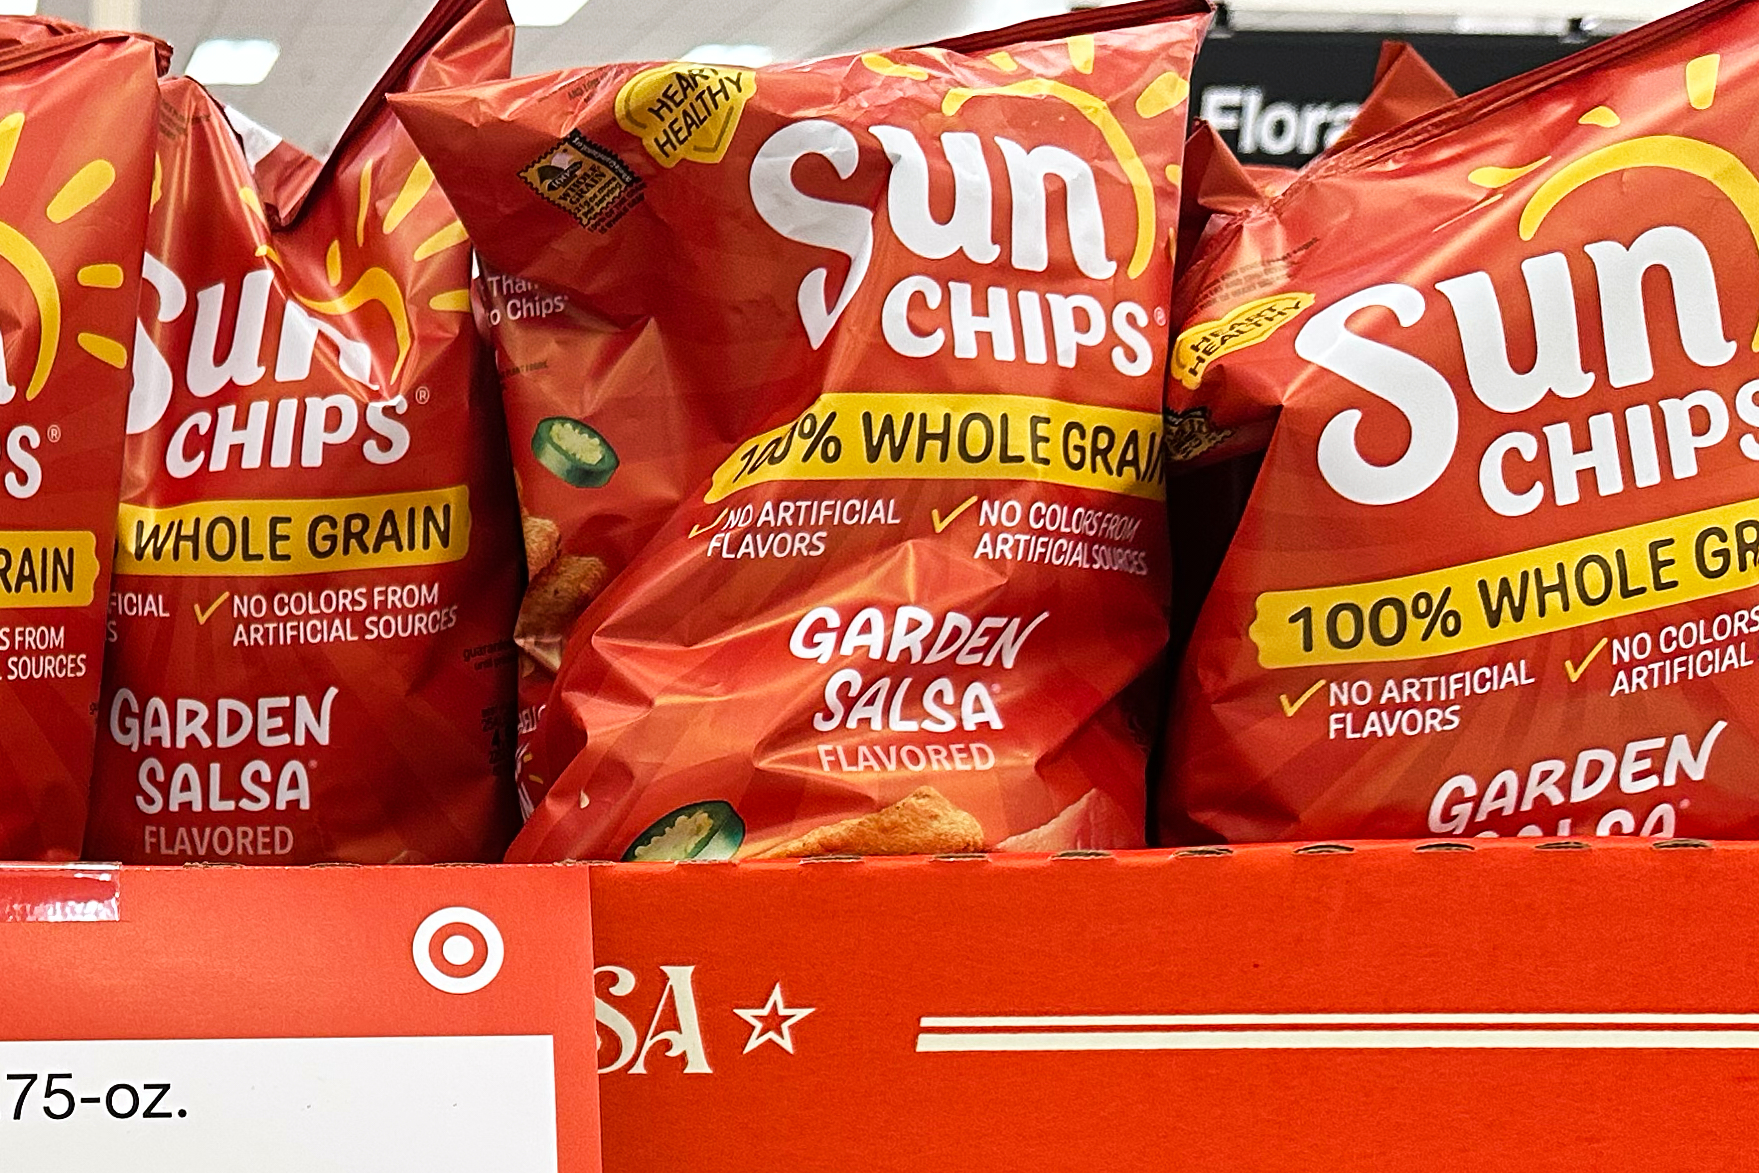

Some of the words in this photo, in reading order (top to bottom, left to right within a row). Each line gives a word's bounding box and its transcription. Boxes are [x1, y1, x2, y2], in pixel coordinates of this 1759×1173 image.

[654, 72, 743, 158] HEALTHY
[749, 119, 1118, 351] Sun
[1187, 301, 1302, 377] HEALTHY
[1294, 226, 1738, 505] Sun
[861, 410, 1051, 466] WHOLE
[135, 515, 293, 564] WHOLE
[306, 503, 452, 559] GRAIN
[723, 506, 756, 530] NO
[757, 498, 901, 528] ARTIFICIAL
[979, 499, 1021, 528] NO
[1029, 502, 1100, 538] COLORS
[706, 530, 827, 559] FLAVORS
[973, 531, 1091, 568] ARTIFICIAL
[233, 595, 267, 618] NO
[273, 588, 367, 614] COLORS
[373, 582, 440, 609] FROM
[1288, 586, 1462, 653] 100%
[1477, 536, 1679, 629] WHOLE
[15, 625, 65, 650] FROM
[233, 618, 359, 647] ARTIFICIAL
[365, 604, 458, 640] SOURCES
[788, 605, 1051, 669] GARDEN
[1611, 631, 1652, 665] NO
[1659, 604, 1759, 654] COLORS
[7, 654, 87, 681] SOURCES
[1328, 680, 1373, 708] NO
[1379, 659, 1535, 704] ARTIFICIAL
[1609, 641, 1755, 697] ARTIFICIAL
[109, 686, 339, 753] GARDEN
[813, 668, 1005, 733] SALSA
[1328, 704, 1461, 739] FLAVORS
[818, 742, 997, 773] FLAVORED
[1428, 719, 1728, 835] GARDEN
[135, 757, 311, 815] SALSA
[144, 825, 294, 857] FLAVORED
[593, 964, 713, 1075] SA
